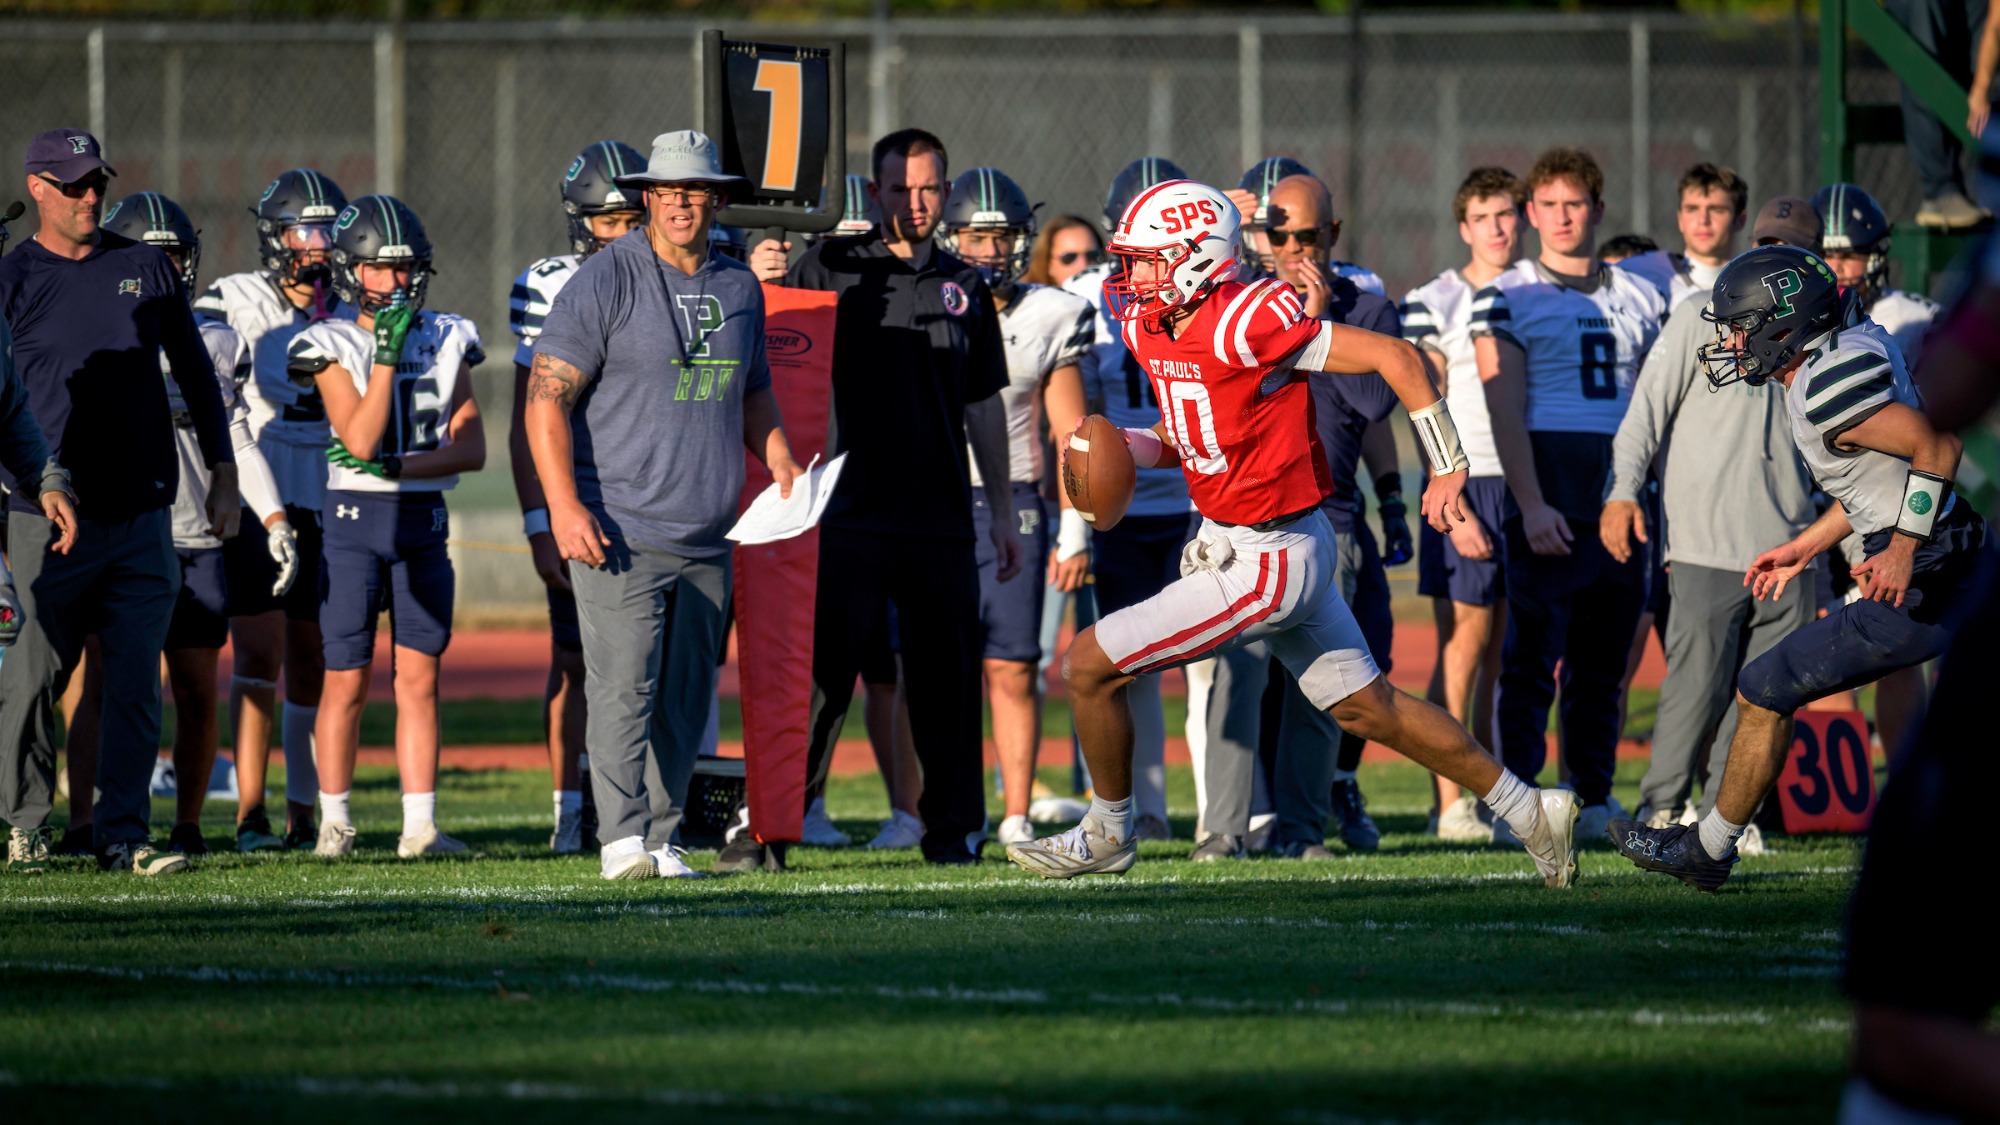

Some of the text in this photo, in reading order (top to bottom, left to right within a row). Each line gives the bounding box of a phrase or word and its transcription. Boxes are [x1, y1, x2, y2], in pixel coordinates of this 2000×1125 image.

[67, 135, 89, 154] P
[752, 59, 803, 192] 1
[1160, 200, 1217, 235] SPS
[1776, 201, 1793, 219] B
[1266, 289, 1304, 331] 10
[1761, 268, 1802, 319] P
[676, 295, 726, 357] P
[674, 368, 734, 401] RDV
[1149, 359, 1202, 379] ST. PAUL'S
[1581, 333, 1617, 400] 8
[1156, 377, 1229, 475] 10
[1788, 718, 1870, 816] 30
